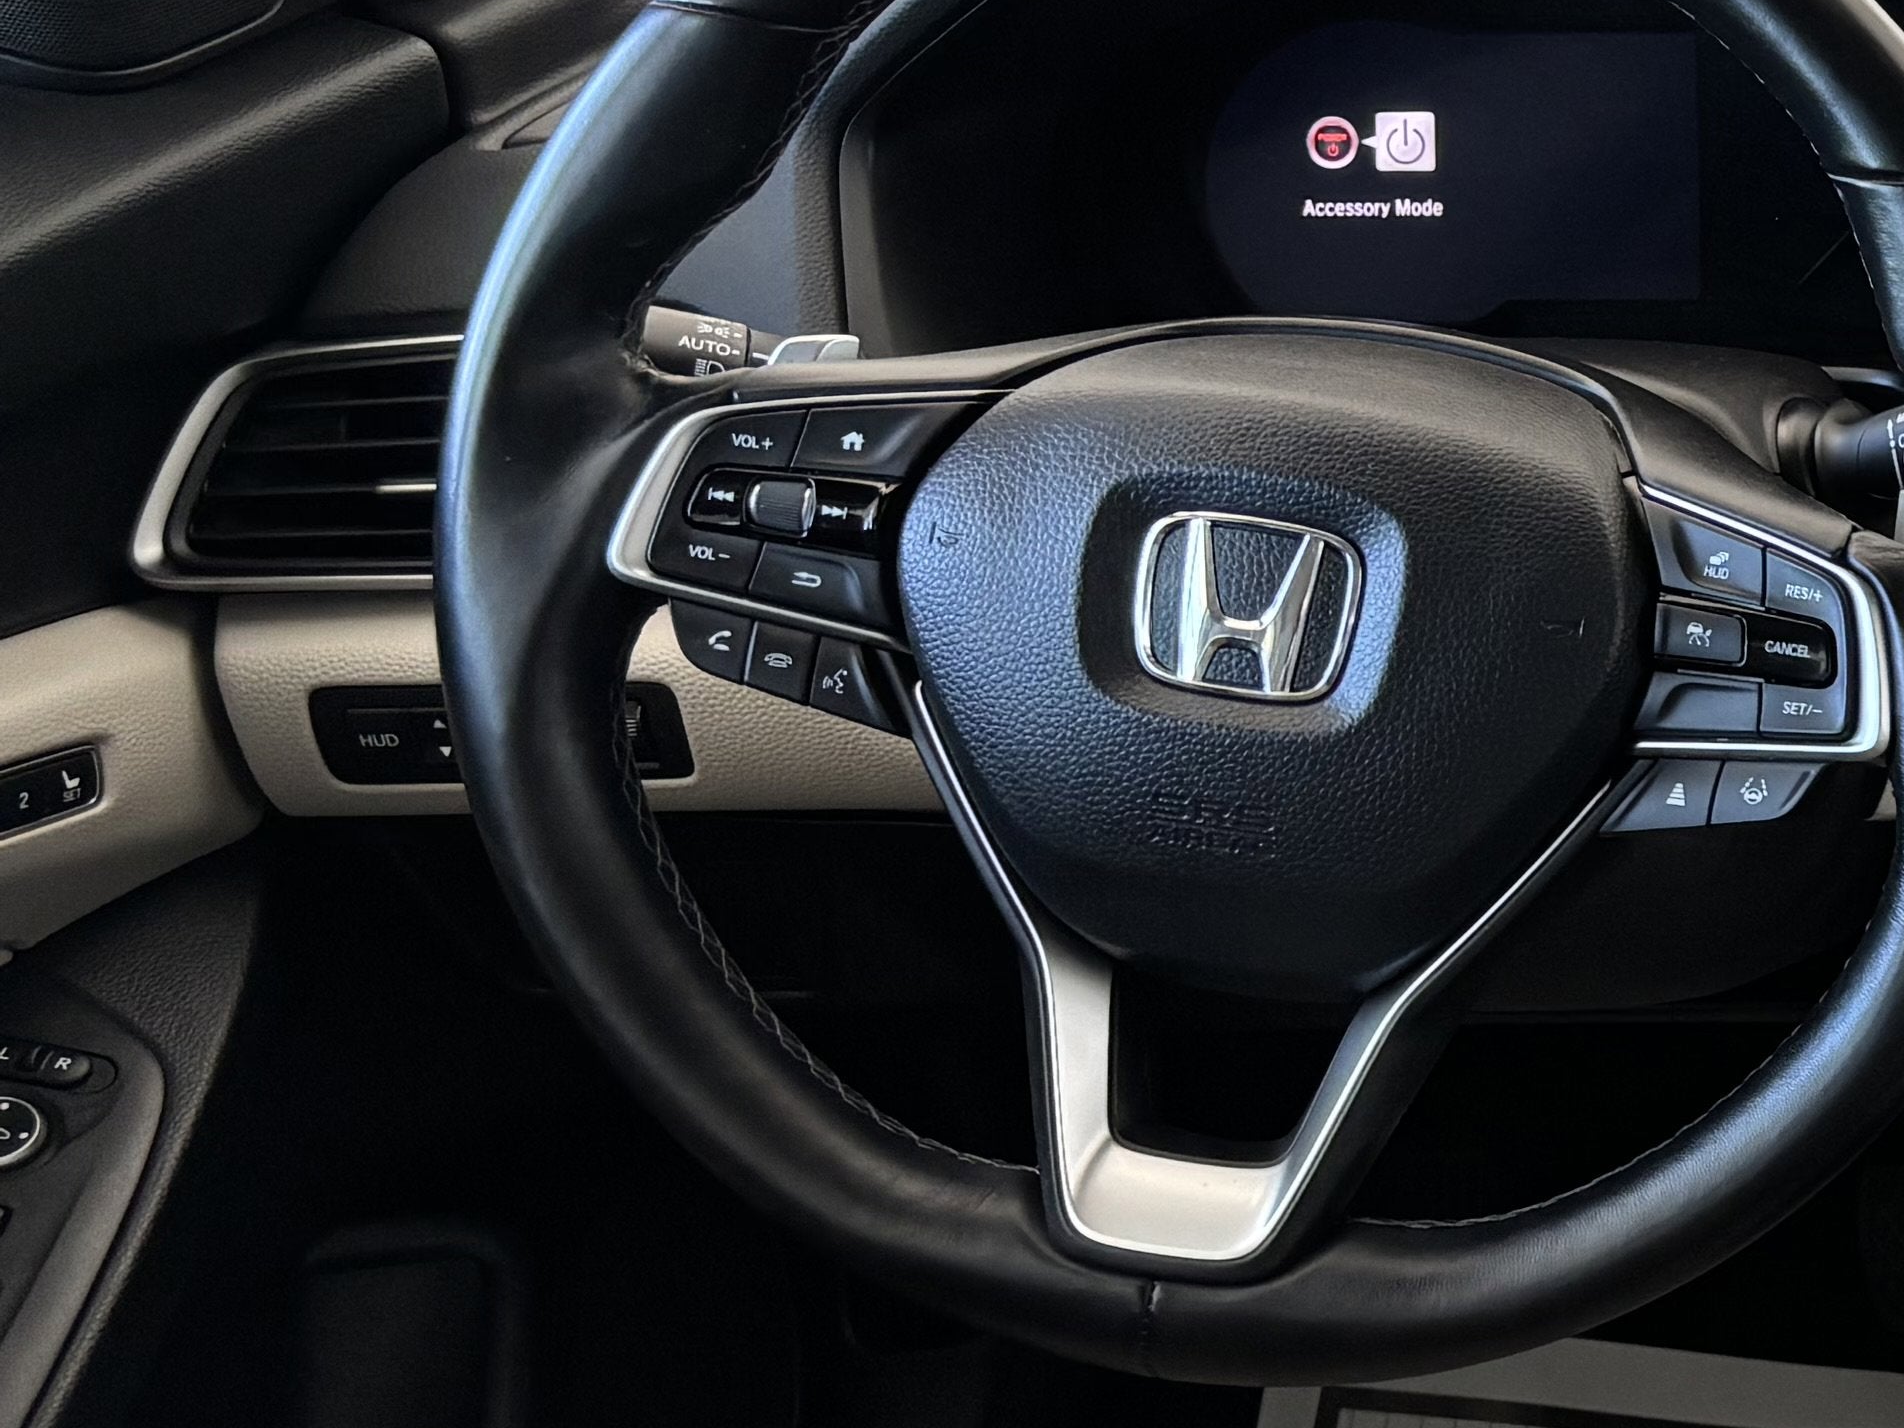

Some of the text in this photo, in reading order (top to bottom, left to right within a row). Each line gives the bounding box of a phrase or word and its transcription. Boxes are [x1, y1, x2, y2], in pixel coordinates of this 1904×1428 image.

[1302, 199, 1443, 219] Accessory Mode
[1703, 565, 1730, 580] HUD
[1764, 640, 1811, 659] CANCEL
[358, 732, 400, 748] HUD
[19, 791, 30, 810] 2
[54, 1056, 73, 1071] R
